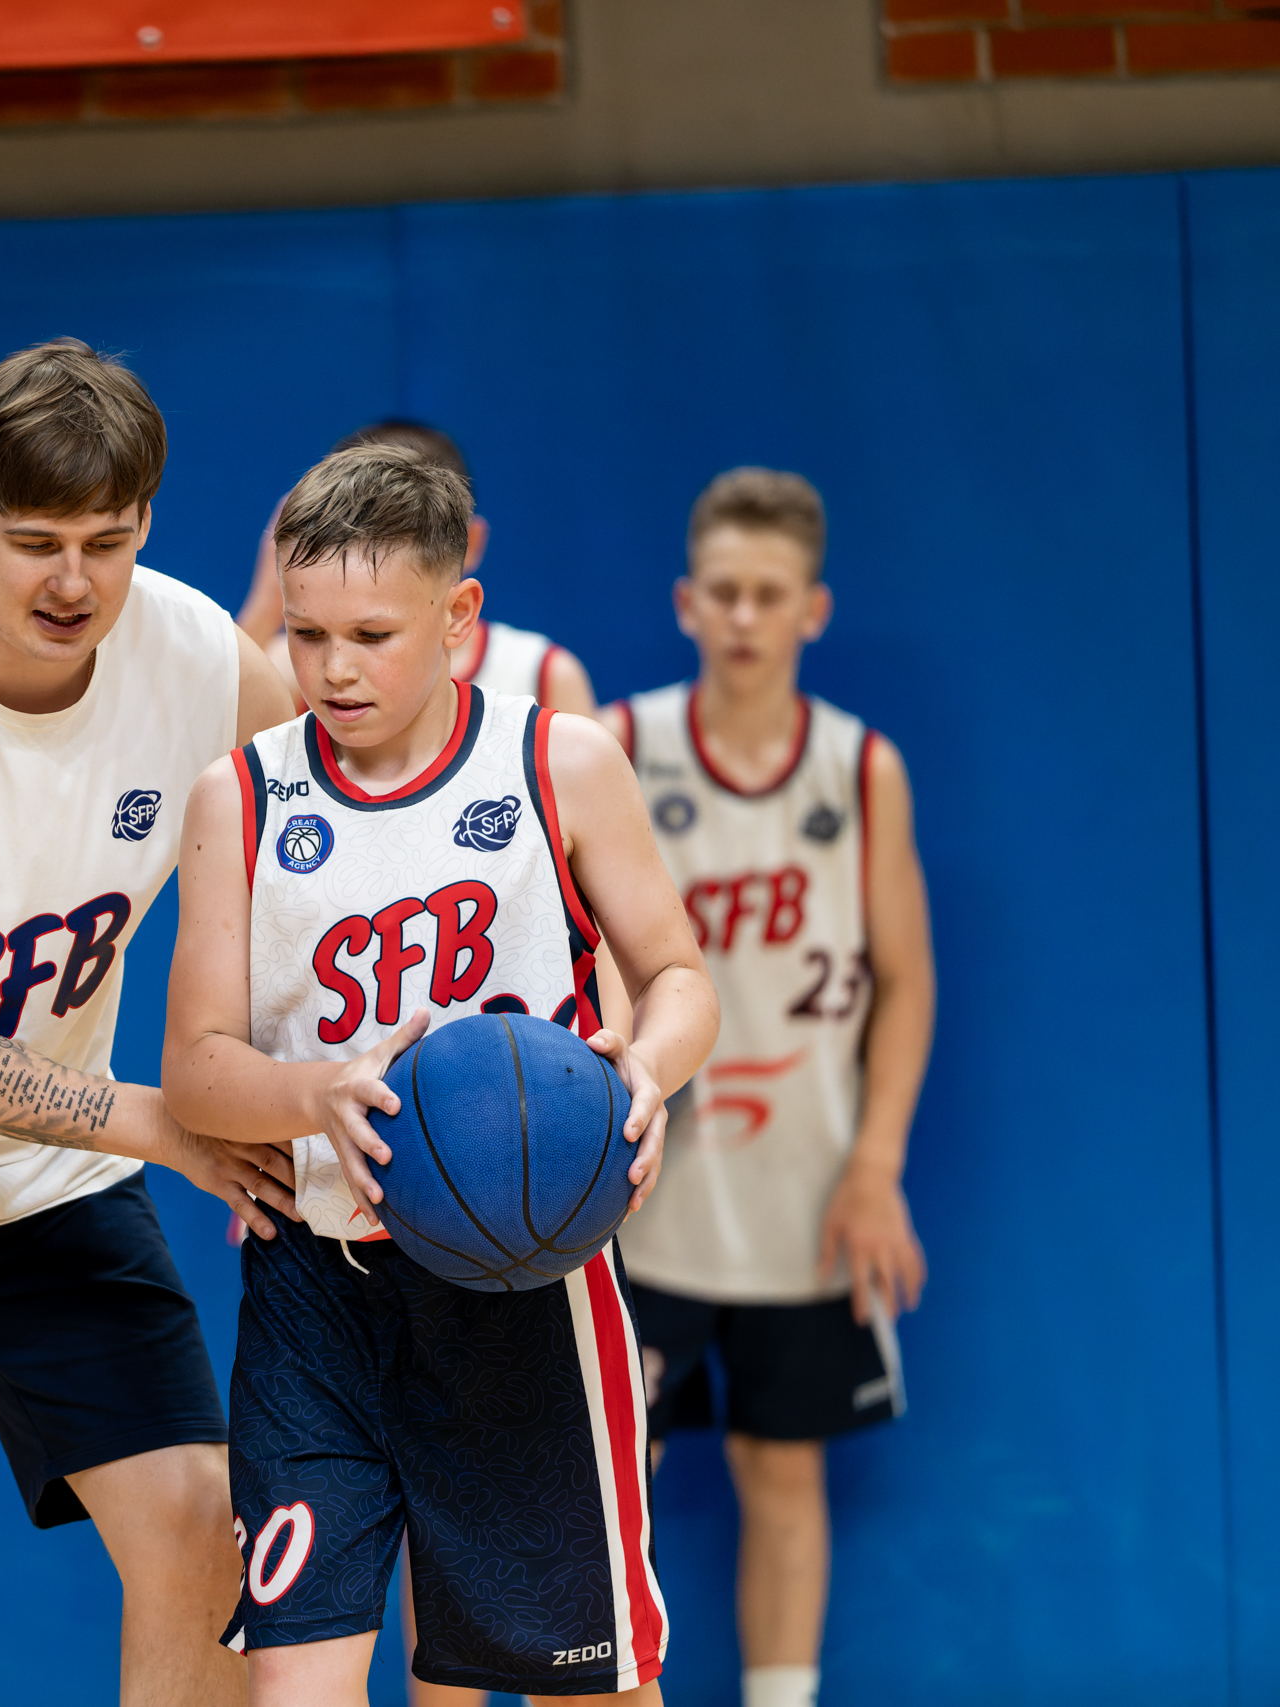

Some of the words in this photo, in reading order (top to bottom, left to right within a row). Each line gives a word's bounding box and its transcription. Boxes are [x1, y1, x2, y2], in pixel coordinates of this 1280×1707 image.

[286, 819, 318, 829] CREATE
[287, 855, 322, 870] AGENCY
[681, 865, 809, 954] SFB
[311, 879, 499, 1044] SFB
[233, 1500, 315, 1606] 0
[552, 1641, 612, 1666] ZEDO
